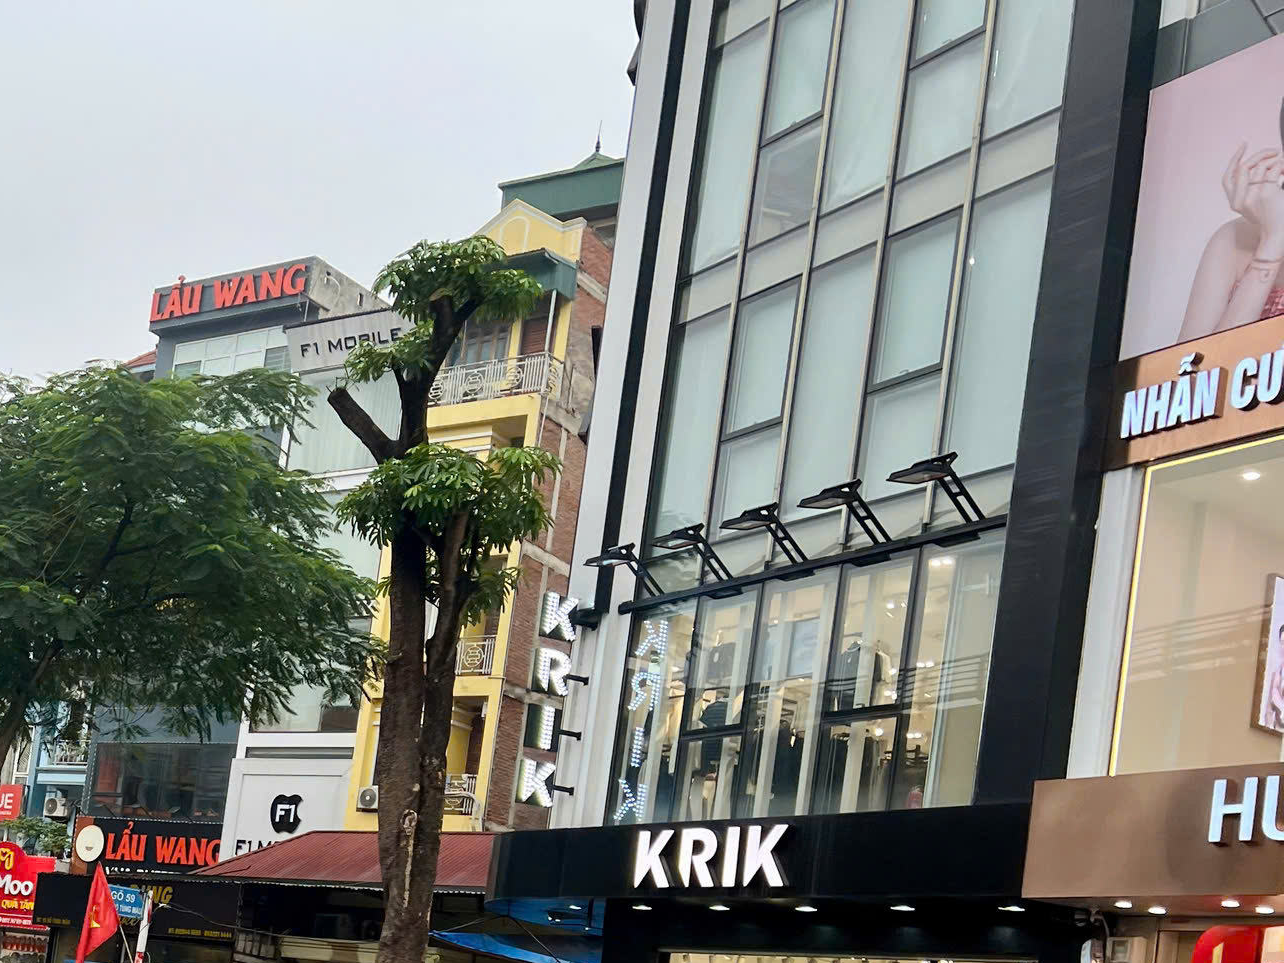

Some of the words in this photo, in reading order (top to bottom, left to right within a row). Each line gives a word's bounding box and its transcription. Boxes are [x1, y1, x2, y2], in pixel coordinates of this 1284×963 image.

[150, 275, 202, 322] LẨU
[213, 264, 306, 308] WANG
[301, 343, 319, 357] F1
[1121, 352, 1224, 438] NHẪN
[520, 591, 578, 807] KRIK
[275, 804, 296, 822] F1
[105, 821, 147, 861] LẨU
[155, 836, 221, 866] WANG
[634, 824, 789, 888] KRIK
[111, 889, 124, 901] GÕ
[125, 893, 135, 903] 59
